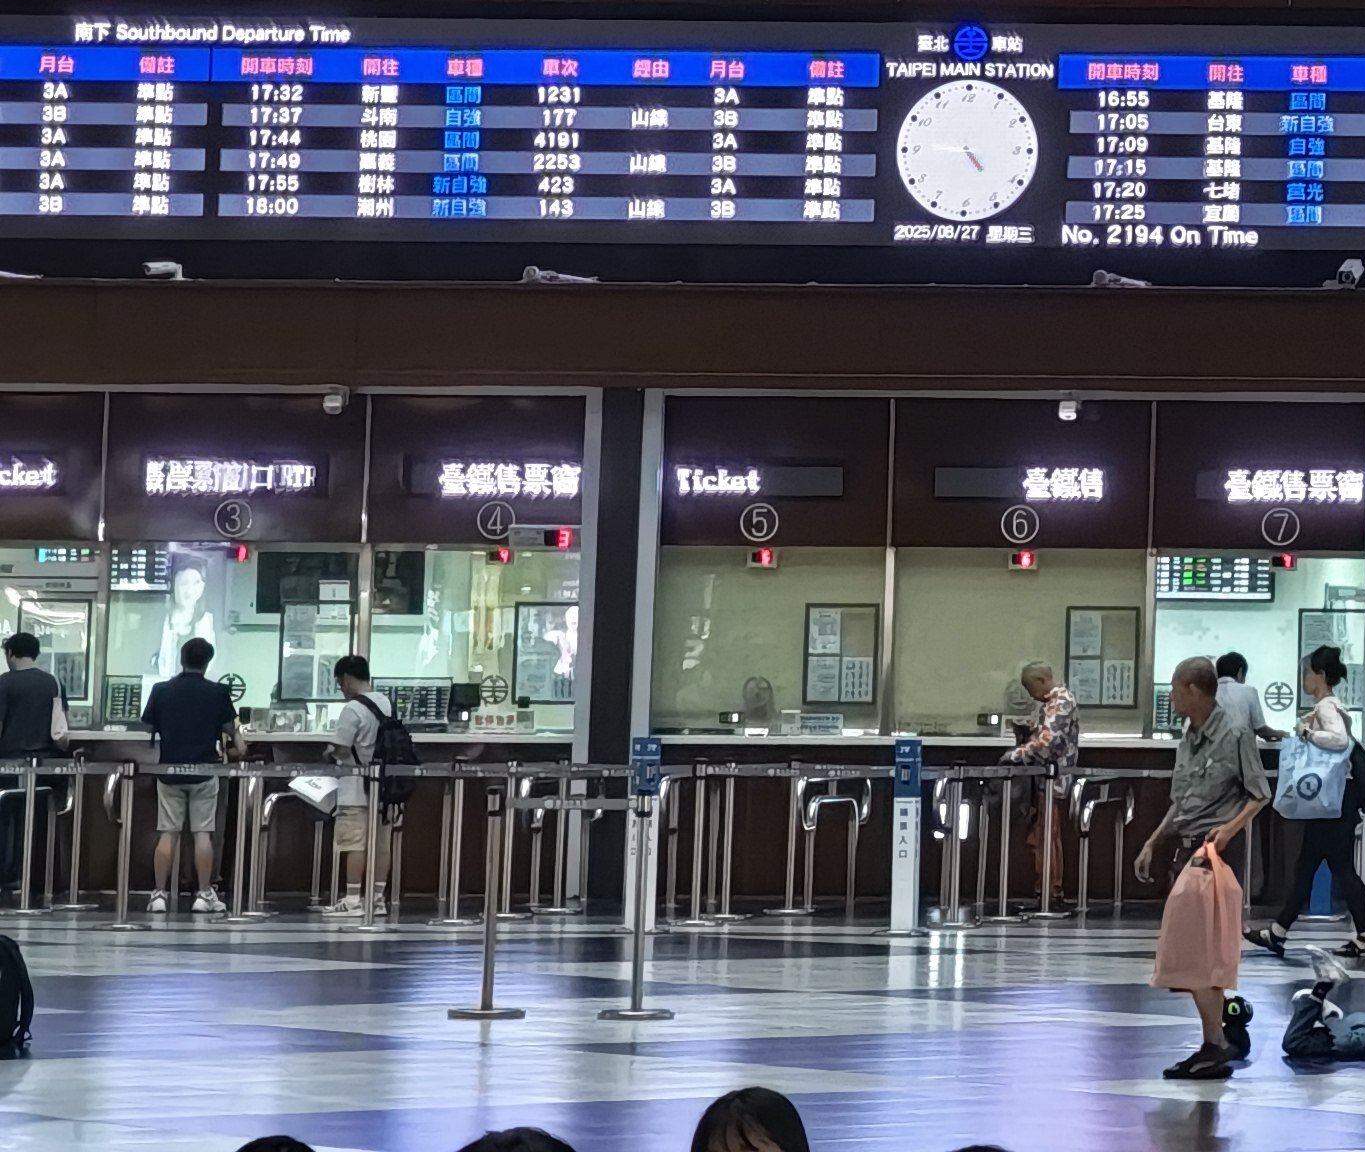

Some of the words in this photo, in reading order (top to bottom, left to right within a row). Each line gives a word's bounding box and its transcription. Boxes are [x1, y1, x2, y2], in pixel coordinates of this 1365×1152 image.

[75, 22, 111, 41] 南下
[116, 24, 218, 40] Southbound
[222, 25, 305, 43] Departure
[309, 25, 351, 42] Time
[40, 56, 74, 73] 月台
[140, 56, 174, 73] 備註
[241, 57, 312, 75] 開車時刻
[364, 59, 398, 75] 開往
[447, 59, 483, 76] 車種
[543, 59, 578, 76] 車次
[634, 60, 669, 77] 經由
[710, 61, 744, 78] 月台
[810, 61, 844, 78] 備註
[886, 63, 936, 77] TAIPEI
[940, 63, 980, 76] MAIN
[985, 63, 1053, 78] STATION
[1089, 63, 1158, 80] 開車時刻
[1209, 65, 1243, 81] 開往
[1292, 65, 1327, 82] 車種
[43, 83, 68, 99] 3A
[252, 84, 303, 101] 17:32
[445, 86, 481, 104] 區間
[538, 86, 580, 103] 1231
[714, 88, 739, 104] 3A
[1099, 91, 1149, 107] 16:55
[43, 105, 66, 121] 3B
[251, 106, 302, 123] 17:37
[445, 108, 481, 127] 自強
[543, 109, 577, 126] 177
[714, 110, 738, 127] 3B
[1098, 114, 1149, 130] 17:05
[42, 128, 66, 144] 3A
[250, 129, 301, 145] 17:44
[444, 131, 479, 149] 區間
[534, 132, 578, 148] 4191
[713, 133, 737, 149] 3A
[1097, 137, 1148, 152] 17:09
[40, 150, 65, 167] 3A
[249, 151, 300, 168] 17:49
[534, 153, 581, 171] 2253
[712, 155, 736, 172] 3B
[1095, 159, 1146, 176] 17:15
[39, 173, 64, 189] 3A
[248, 175, 299, 191] 17:55
[433, 175, 486, 194] 新自強
[539, 176, 574, 193] 423
[711, 178, 736, 194] 3A
[1094, 182, 1145, 198] 17:20
[39, 195, 62, 213] 3B
[247, 197, 298, 215] 18:00
[432, 197, 486, 217] 新自強
[540, 199, 573, 217] 143
[1093, 204, 1145, 220] 17:25
[894, 225, 980, 240] 2025/08/27
[1062, 225, 1098, 244] No.
[1107, 225, 1163, 244] 2194
[1171, 226, 1200, 244] On
[1207, 226, 1258, 245] Time
[676, 468, 761, 493] Ticket
